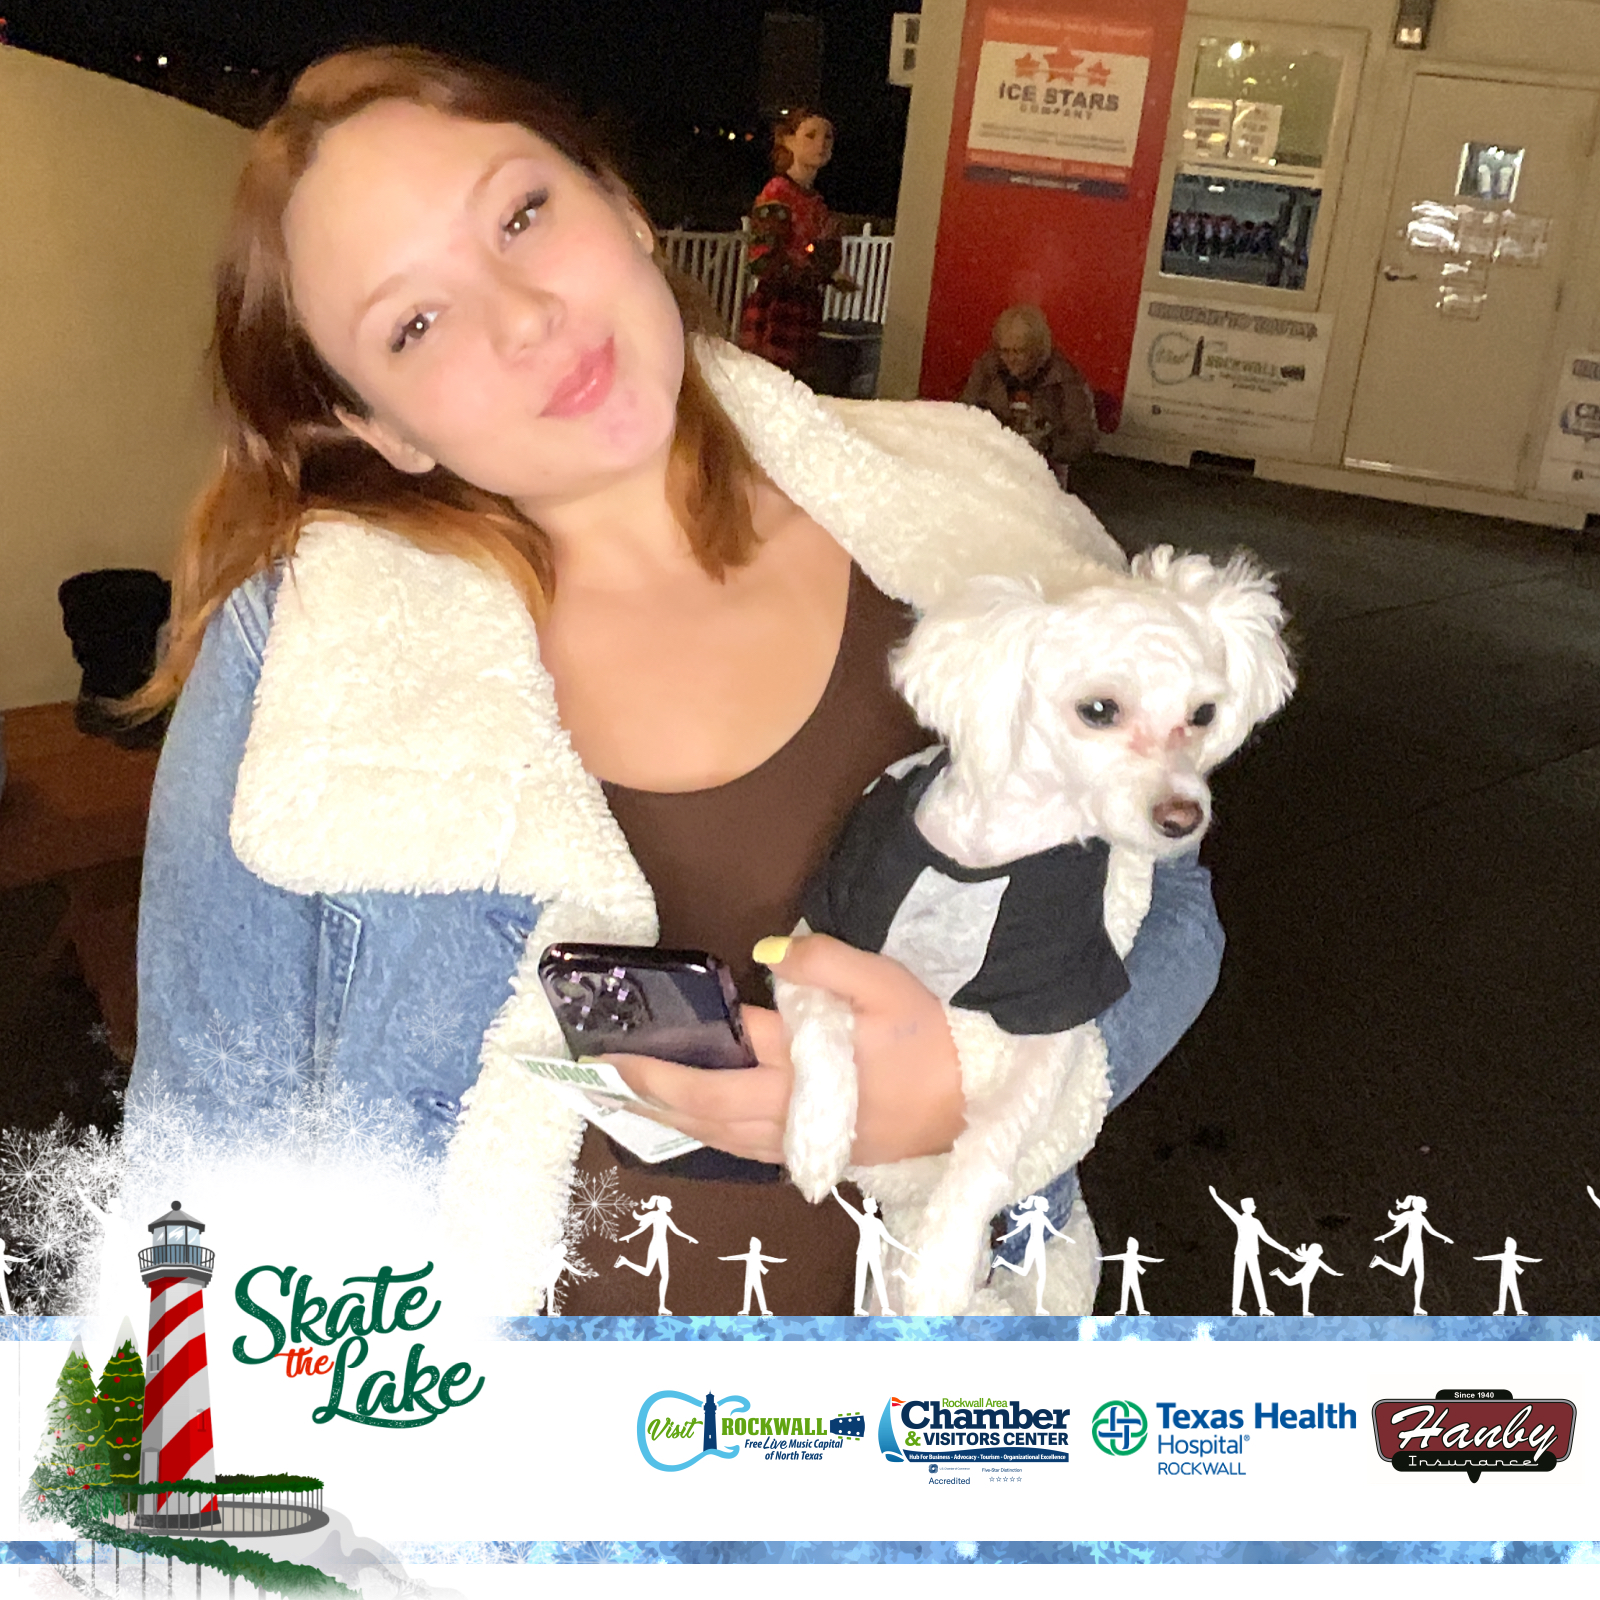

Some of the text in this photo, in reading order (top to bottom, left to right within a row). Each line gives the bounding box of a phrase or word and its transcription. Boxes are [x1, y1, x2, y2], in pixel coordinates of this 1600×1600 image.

[998, 80, 1120, 112] ICE STARS
[1018, 103, 1094, 121] COMPANY
